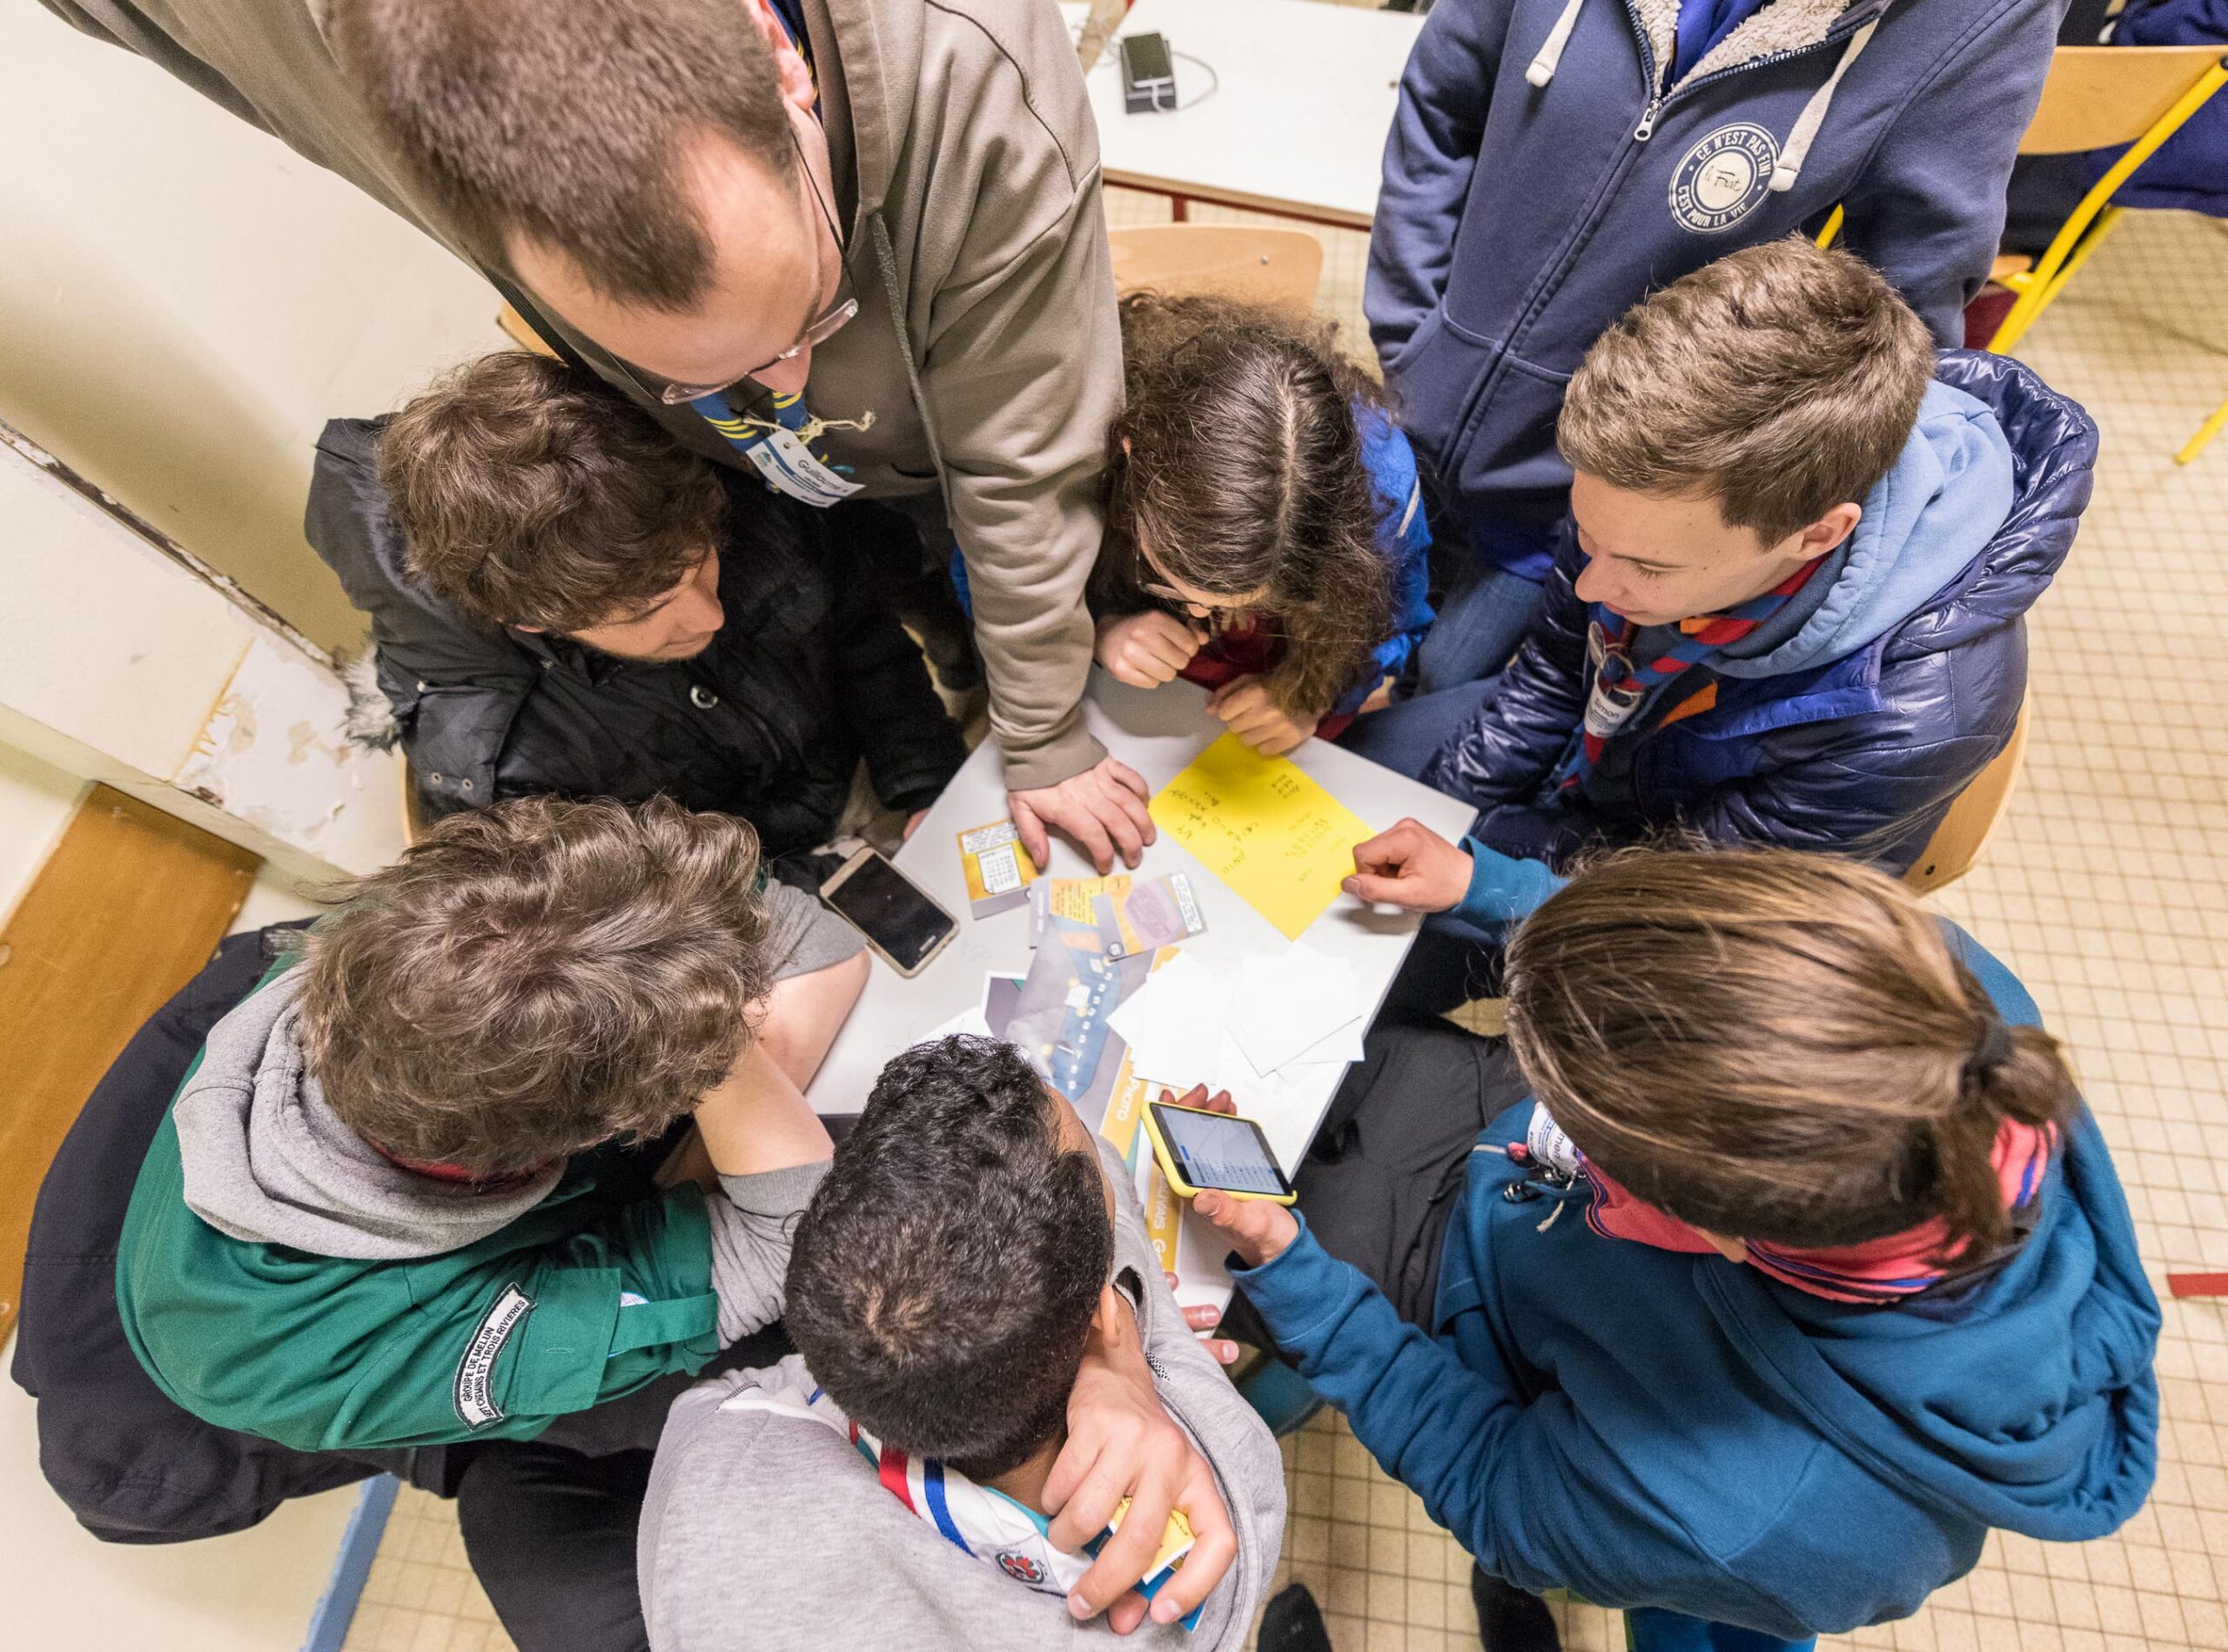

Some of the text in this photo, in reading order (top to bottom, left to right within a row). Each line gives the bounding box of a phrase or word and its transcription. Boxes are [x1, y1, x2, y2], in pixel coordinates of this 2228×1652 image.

[1695, 131, 1771, 177] CE N'EST PAS FINI
[1678, 185, 1748, 227] C'EST POUR LA VIE
[1594, 697, 1620, 719] Simon
[497, 1299, 526, 1335] RIVIERES
[462, 1326, 494, 1401] GROUPE DE MELUN
[480, 1335, 500, 1361] TROIS
[477, 1363, 487, 1374] ET
[473, 1376, 486, 1407] CHEMINS
